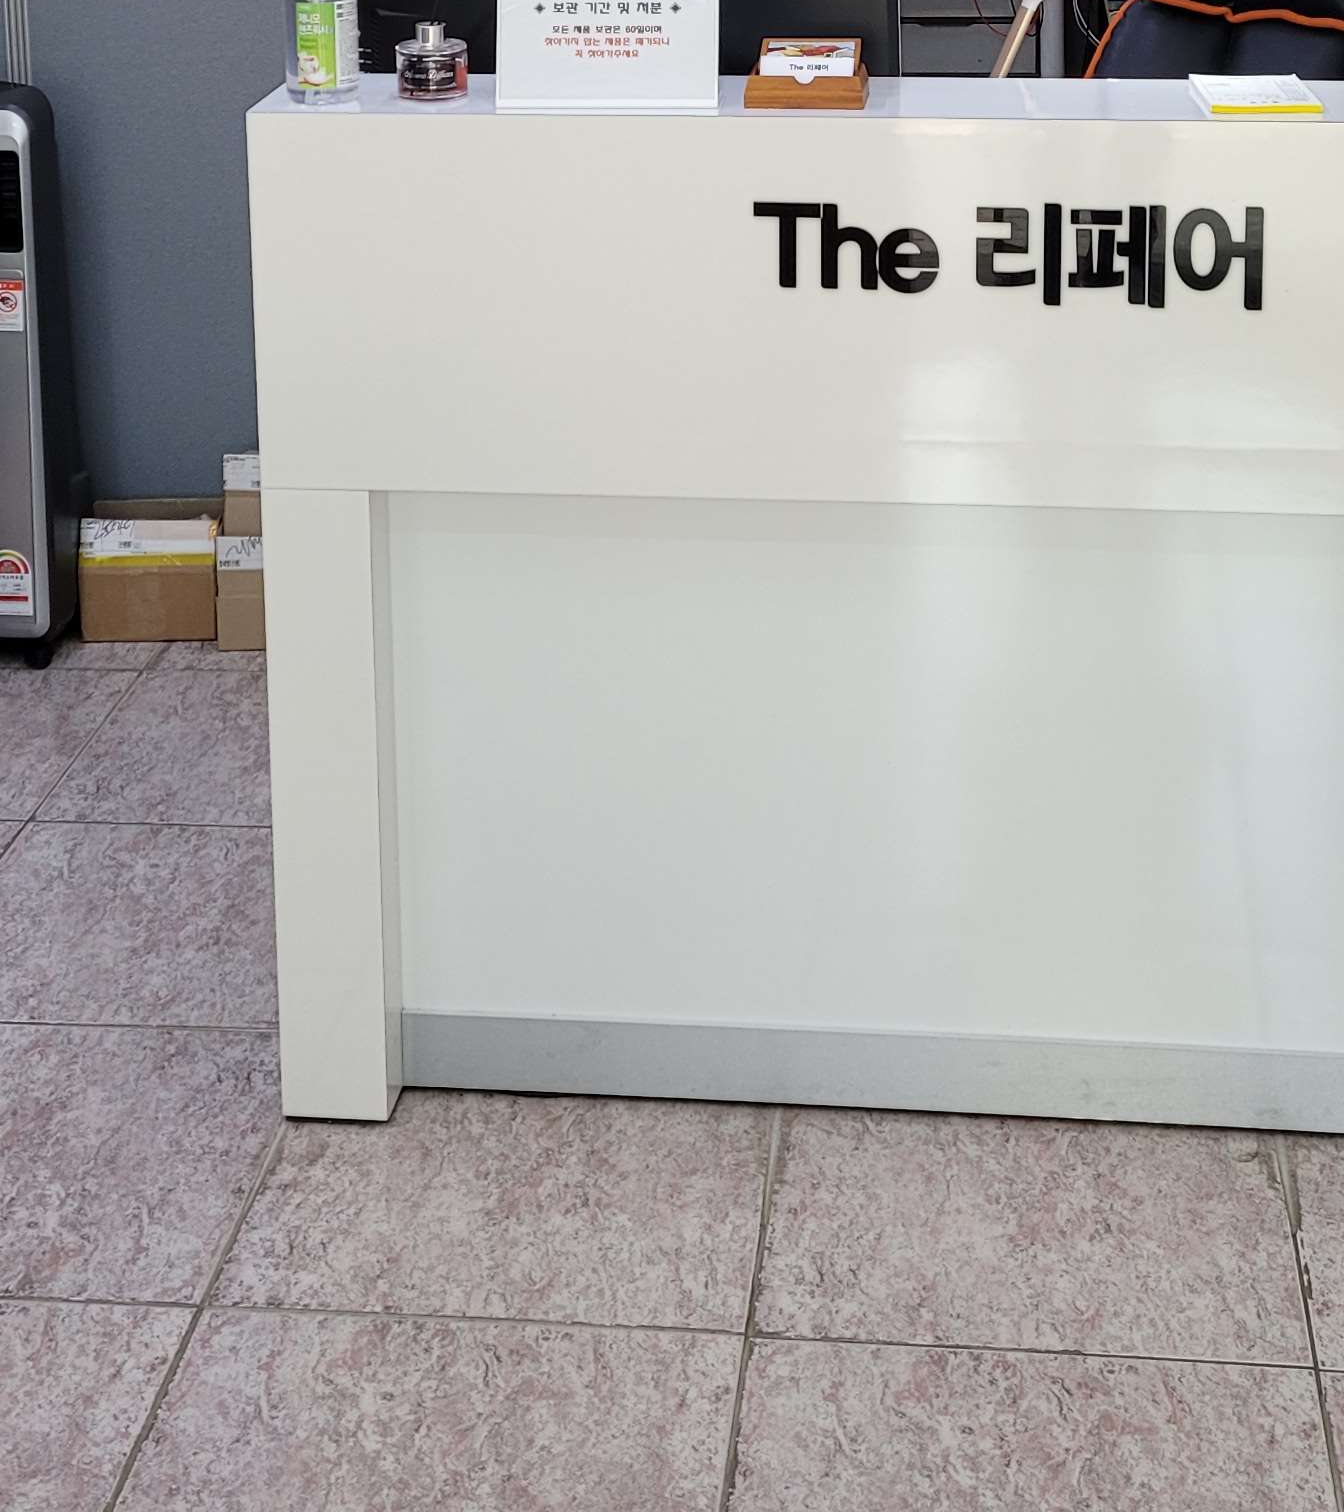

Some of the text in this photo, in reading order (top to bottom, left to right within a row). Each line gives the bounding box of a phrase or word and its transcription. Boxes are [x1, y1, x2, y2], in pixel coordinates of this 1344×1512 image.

[552, 2, 662, 15] 보관 기간 및 처분
[753, 201, 1265, 311] The 리페어
